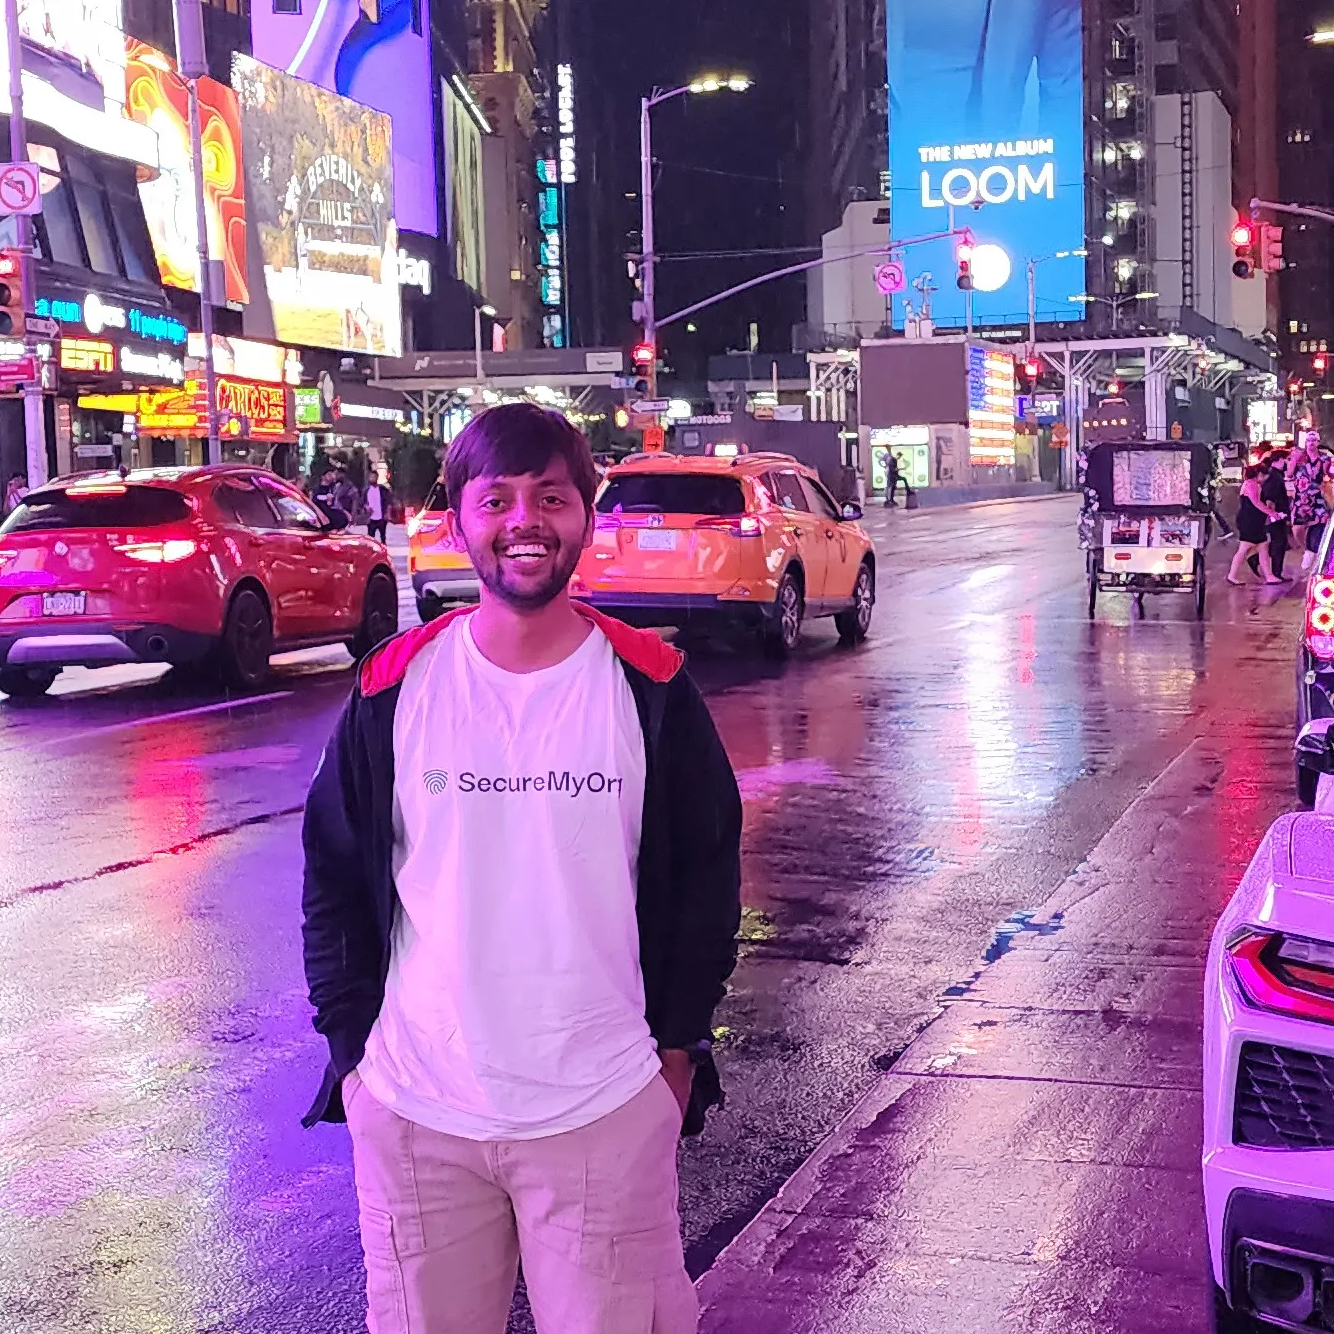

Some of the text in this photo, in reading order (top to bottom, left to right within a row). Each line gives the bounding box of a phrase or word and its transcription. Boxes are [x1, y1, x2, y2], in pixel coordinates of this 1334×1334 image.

[918, 138, 1054, 163] THE NEW ALBUM
[306, 154, 362, 198] BEVERLY
[921, 161, 1055, 208] LOOM
[319, 199, 352, 227] HILLS
